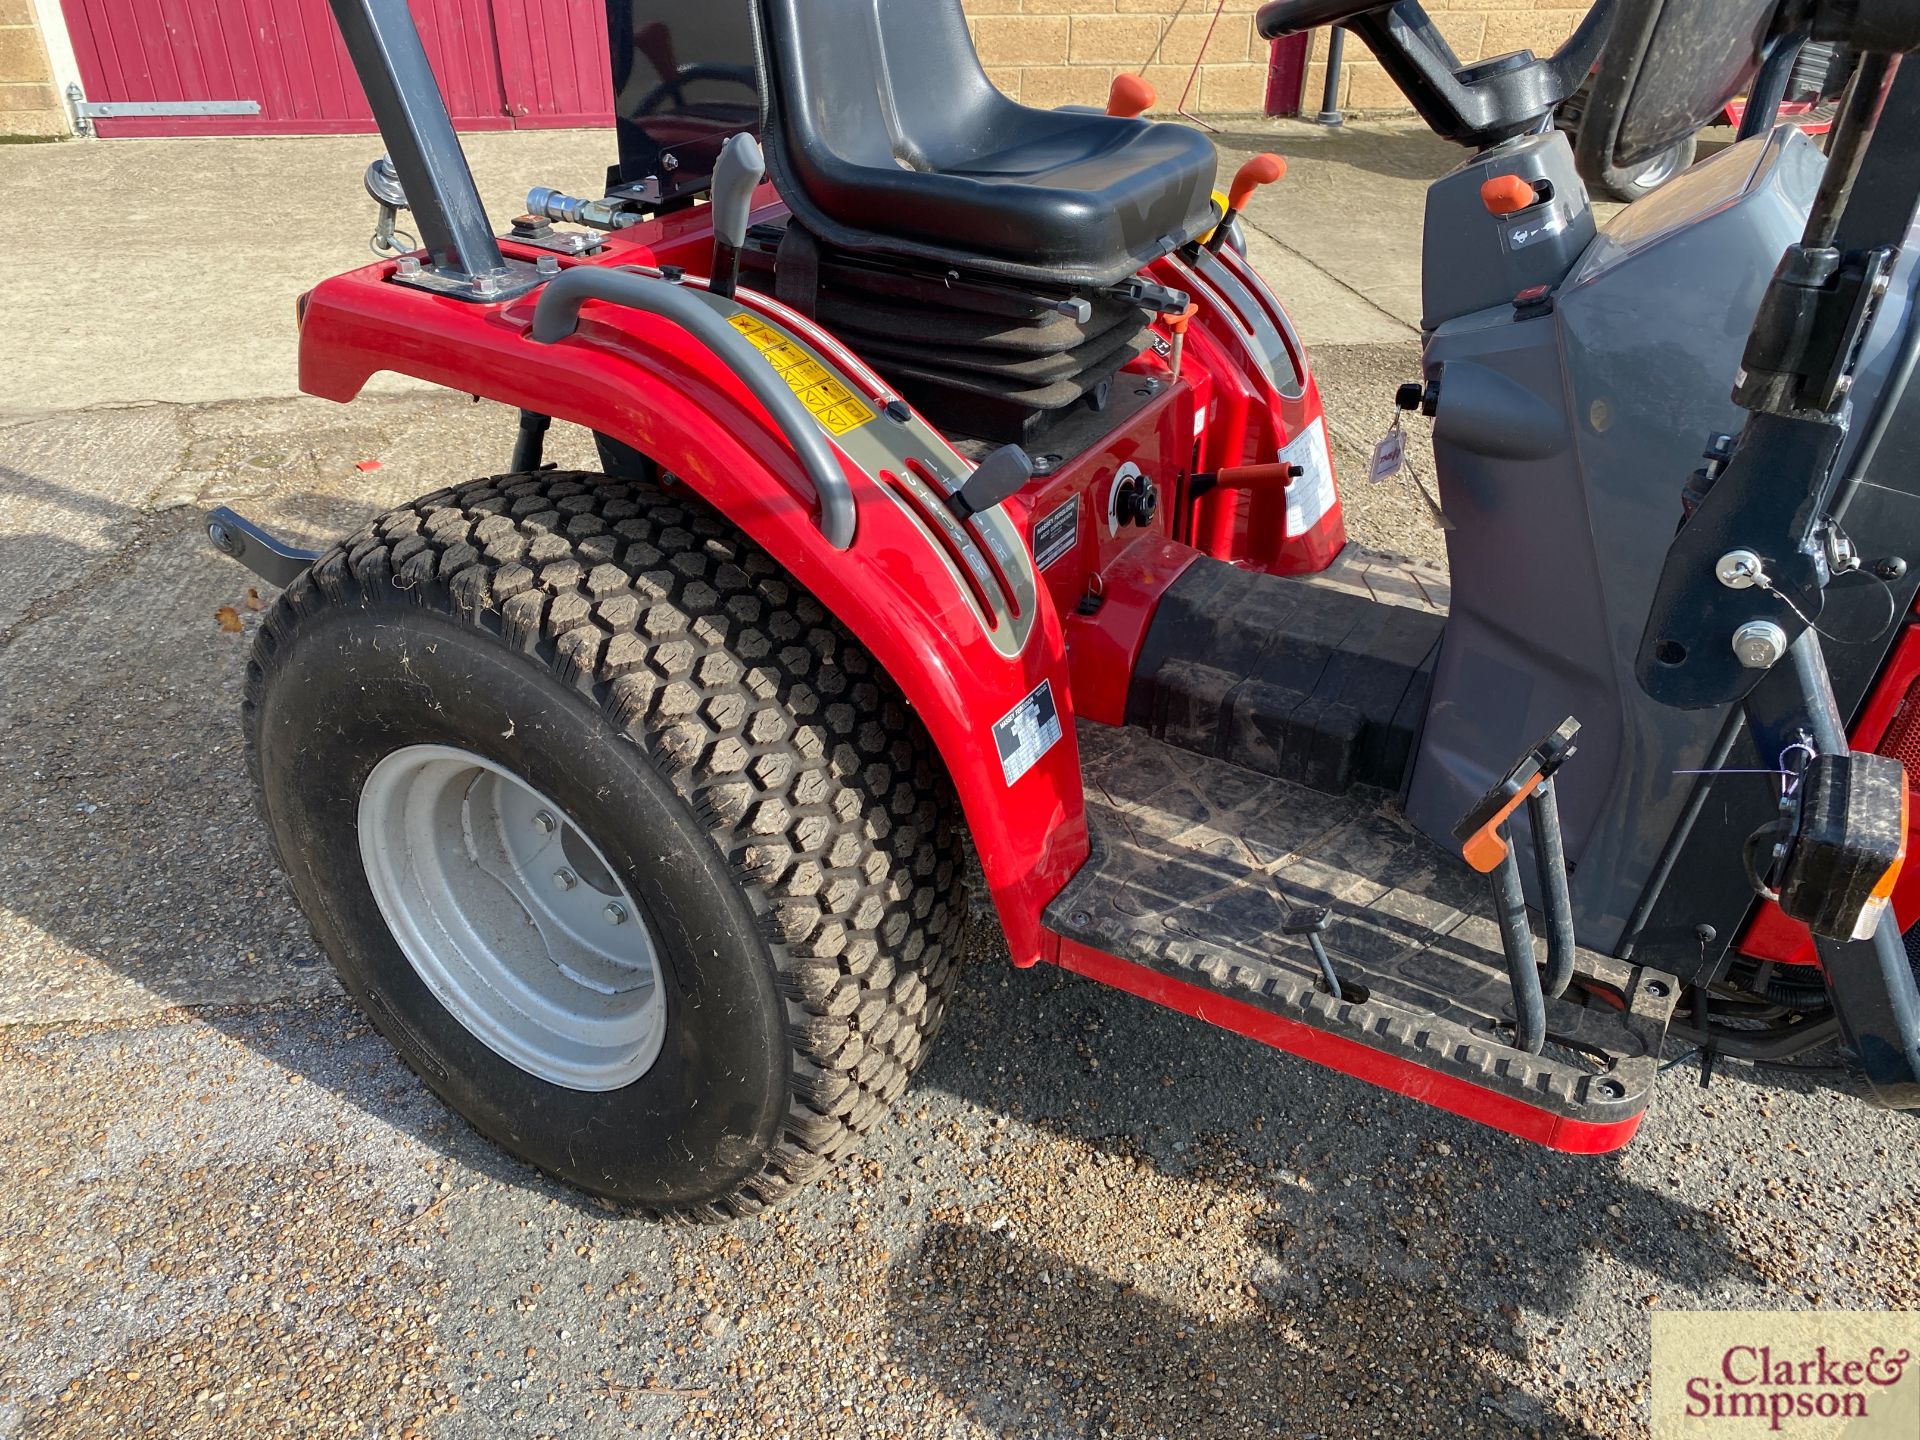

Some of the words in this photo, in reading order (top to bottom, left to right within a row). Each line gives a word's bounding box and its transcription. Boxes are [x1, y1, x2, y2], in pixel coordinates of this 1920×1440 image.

[1036, 517, 1054, 535] MASSEY
[1055, 501, 1075, 520] FERGUSON
[1000, 712, 1015, 730] MASSEY
[1015, 696, 1034, 716] FERGUSON
